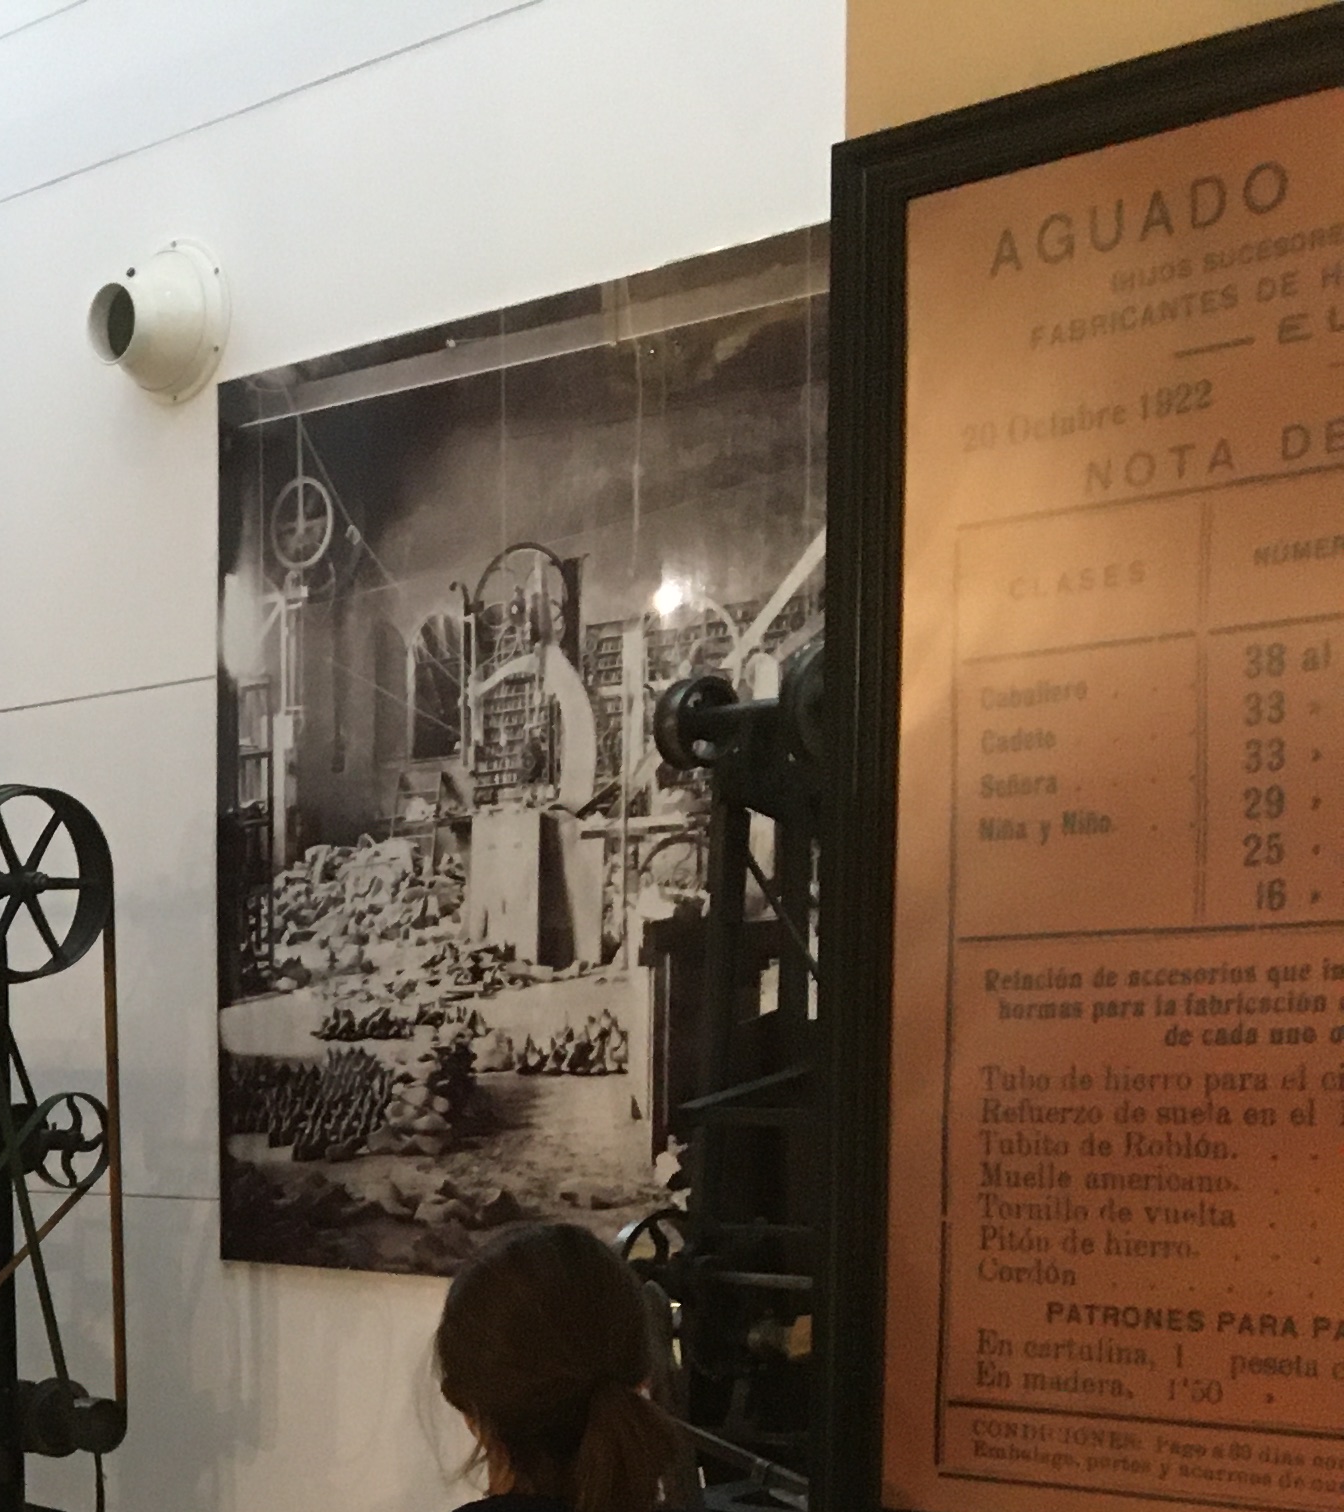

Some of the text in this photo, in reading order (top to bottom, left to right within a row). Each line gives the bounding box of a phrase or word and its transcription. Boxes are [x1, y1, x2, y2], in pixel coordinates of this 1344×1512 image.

[990, 160, 1289, 278] AGUADO
[1201, 222, 1344, 273] SUCESORE
[1028, 262, 1344, 351] FABRICANTES DE H
[1278, 304, 1344, 345] EL
[1139, 379, 1212, 422] 1922
[1085, 436, 1235, 494] NOTA
[1008, 560, 1147, 601] CLASES
[1245, 641, 1287, 680] 38
[1301, 637, 1332, 672] al
[981, 689, 1286, 756] Cadete 33
[979, 735, 1286, 800] Señora 33
[1040, 819, 1052, 846] y
[1242, 783, 1286, 820] 29
[1242, 831, 1286, 868] 25
[1255, 877, 1288, 912] 16
[1093, 966, 1119, 988] de
[1128, 960, 1257, 988] accesorios
[1267, 963, 1312, 989] que
[998, 998, 1083, 1021] hormas
[1092, 1000, 1145, 1024] para
[1155, 993, 1177, 1017] la
[1164, 1024, 1194, 1047] de
[1201, 1022, 1258, 1047] cada
[1269, 1027, 1319, 1045] uno
[980, 1063, 1051, 1092] Tubo
[1061, 1065, 1093, 1091] de
[1104, 1065, 1192, 1093] hierro
[1204, 1071, 1269, 1098] para
[1280, 1066, 1308, 1094] el
[981, 1098, 1316, 1127] Refuerzo de suela en el
[979, 1129, 1070, 1158] Tubito
[1080, 1131, 1113, 1158] de
[979, 1162, 1072, 1190] Muelle
[979, 1193, 1237, 1229] Tornillo de vuelta
[979, 1224, 1050, 1253] Pitón
[1061, 1228, 1095, 1255] de
[978, 1258, 1077, 1287] Cordón
[1046, 1301, 1344, 1343] PATRONES PARA PA
[977, 1328, 1012, 1358] En
[1230, 1353, 1319, 1381] peseta
[976, 1360, 1011, 1389] En
[1158, 1462, 1170, 1481] y
[1278, 1470, 1305, 1489] de
